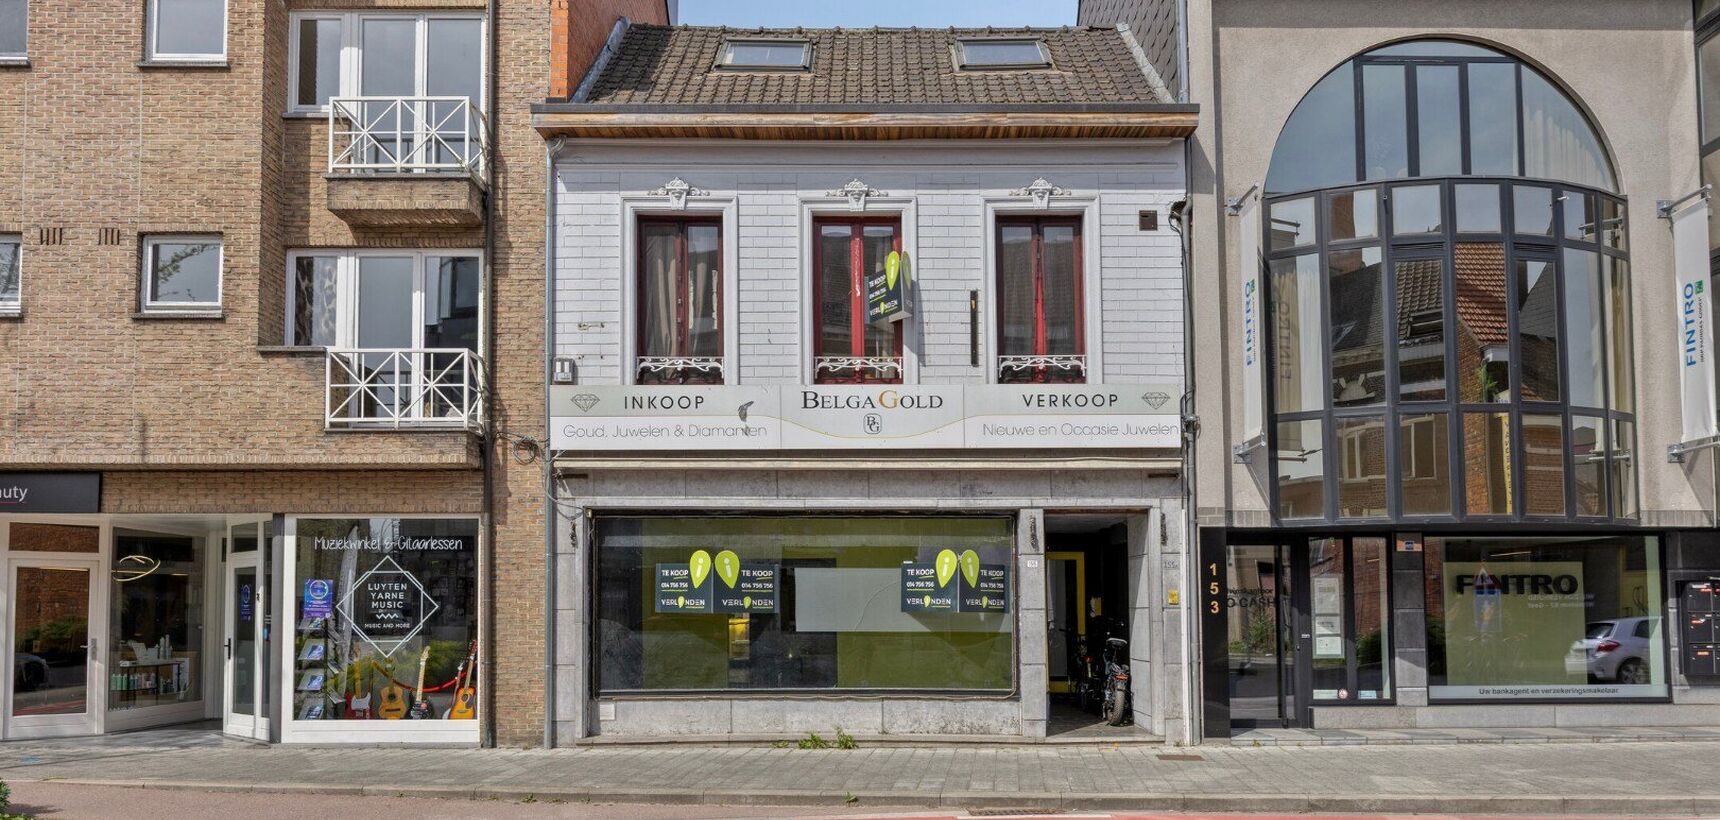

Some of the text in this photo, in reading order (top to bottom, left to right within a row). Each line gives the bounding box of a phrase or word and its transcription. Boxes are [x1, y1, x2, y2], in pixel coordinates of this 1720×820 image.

[1245, 282, 1253, 367] FINTRO
[1684, 283, 1696, 367] FINTRO
[624, 396, 705, 410] INKOOP
[1022, 394, 1119, 408] VERKOOP
[612, 424, 670, 438] Juwelen
[675, 424, 684, 438] &
[688, 424, 768, 438] Diamanten
[983, 423, 1179, 436] Nieuwe en Occasie Juwelen
[0, 486, 28, 502] uty
[314, 536, 380, 551] Muziekwinkel
[397, 536, 463, 551] Gitaarlessen
[661, 569, 689, 577] TE KOOP
[741, 569, 773, 577] TE KOOP
[907, 568, 935, 576] TE KOOP
[981, 569, 1004, 577] TE KOOP
[367, 583, 408, 591] LUYTEN
[1456, 574, 1579, 595] FINTRO
[370, 592, 405, 600] YARNE
[371, 601, 404, 609] MUSIC
[1492, 687, 1530, 696] bankagent
